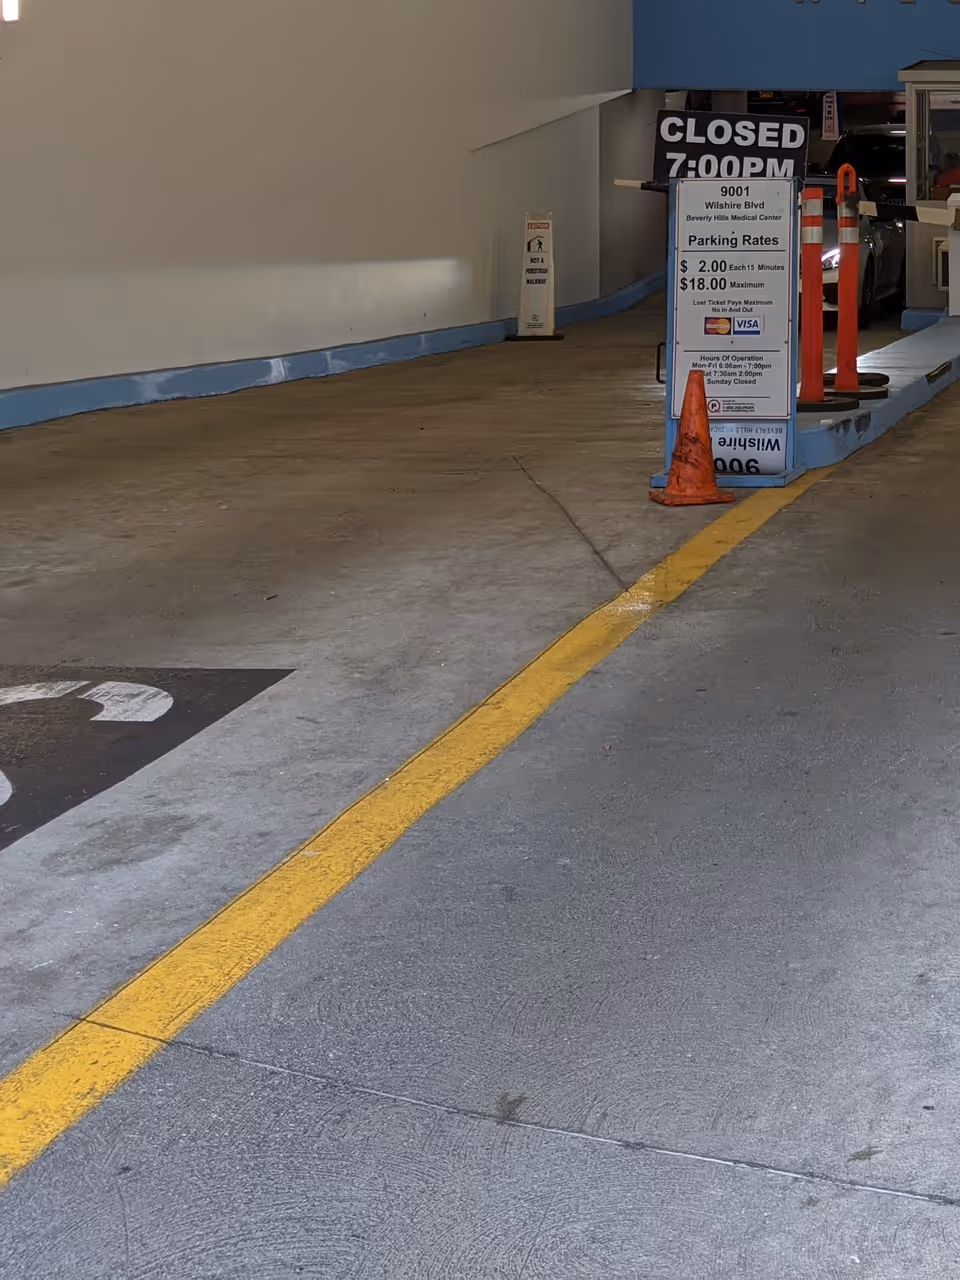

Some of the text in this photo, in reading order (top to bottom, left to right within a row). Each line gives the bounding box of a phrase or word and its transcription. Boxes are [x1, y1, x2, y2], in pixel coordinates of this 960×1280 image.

[660, 116, 805, 148] CLOSED
[666, 152, 794, 178] 7:00PM
[720, 186, 750, 196] 9001
[705, 201, 765, 209] Wilshire Blvd
[688, 235, 779, 248] Parking Rates
[698, 260, 727, 273] 2.00
[680, 277, 727, 291] $18.00
[737, 320, 759, 328] VISA
[718, 437, 781, 451] Wilshire
